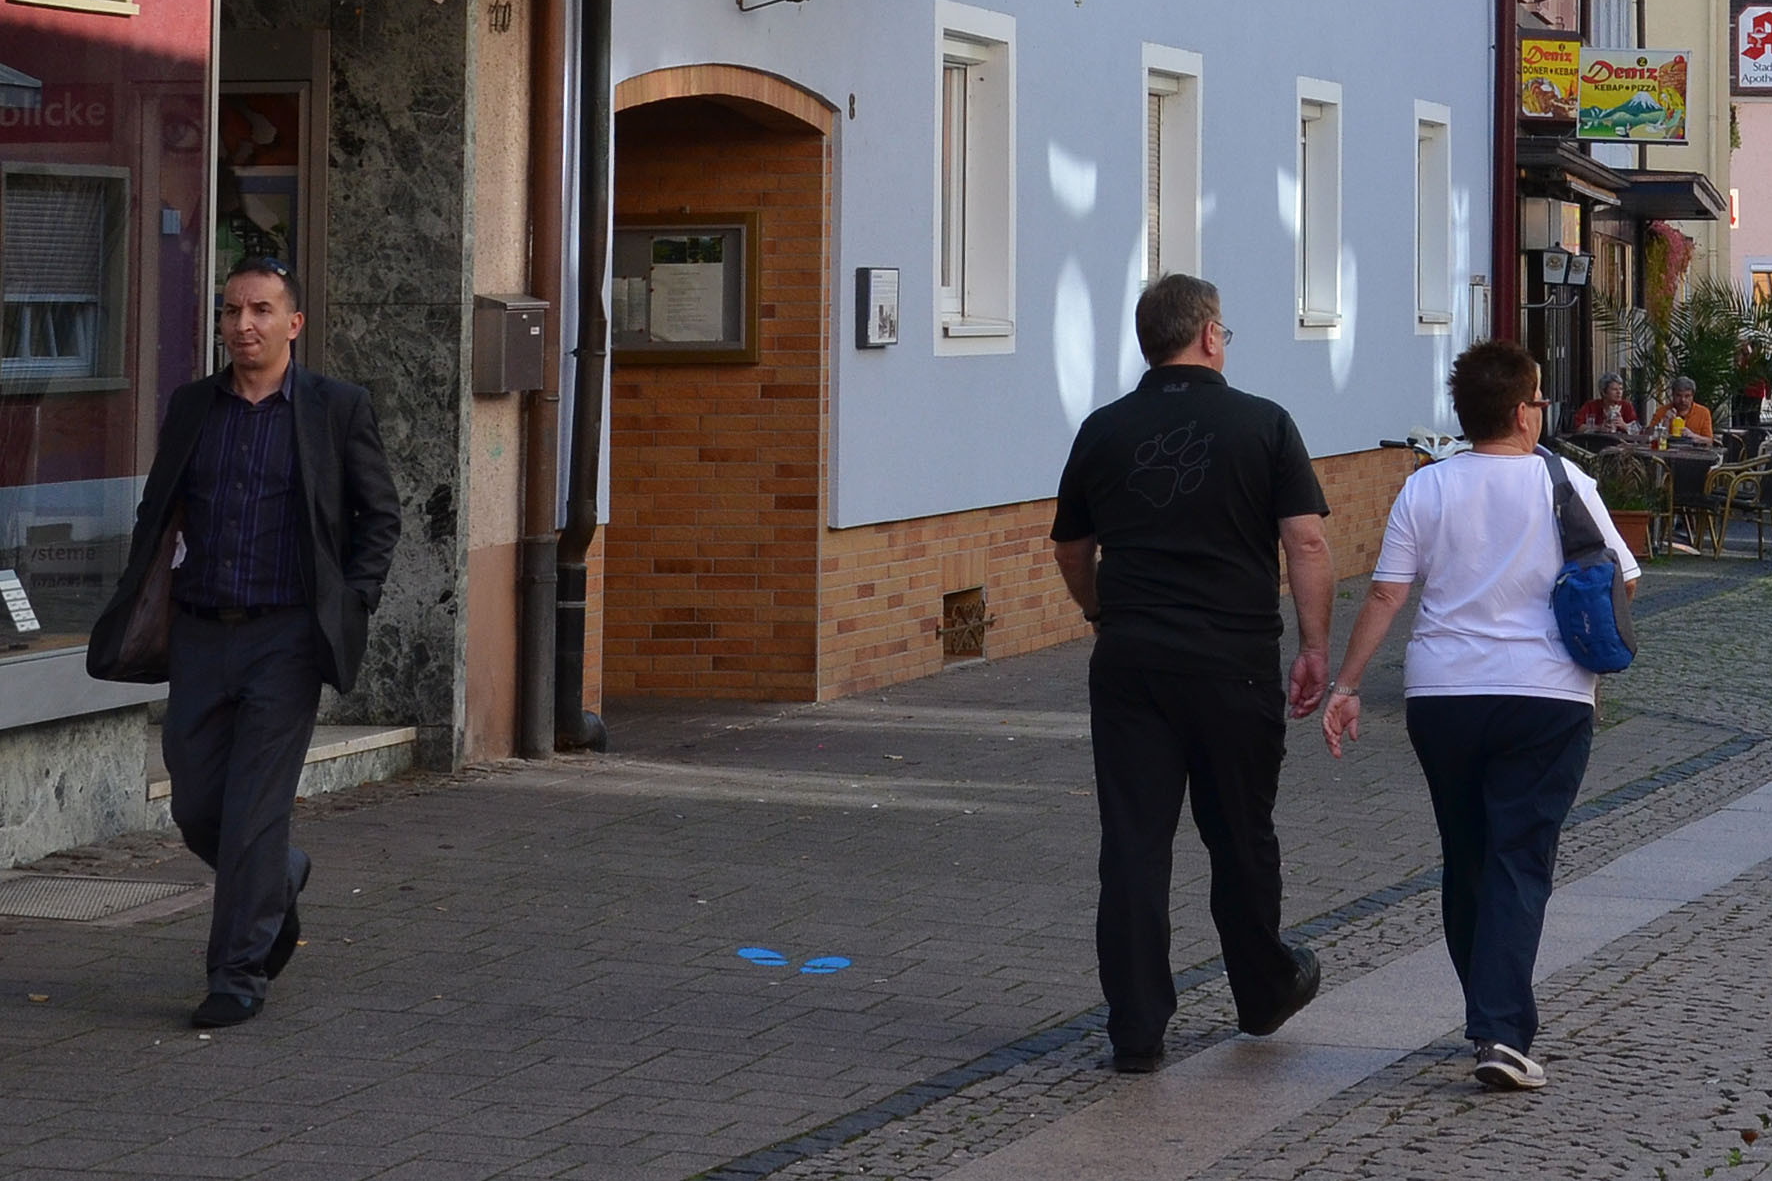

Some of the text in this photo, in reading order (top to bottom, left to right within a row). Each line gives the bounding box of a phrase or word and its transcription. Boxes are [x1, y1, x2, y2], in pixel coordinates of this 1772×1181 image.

[1523, 45, 1573, 65] Deniz
[1581, 60, 1659, 84] Deniz
[1594, 84, 1657, 92] KEBAP PIZZA
